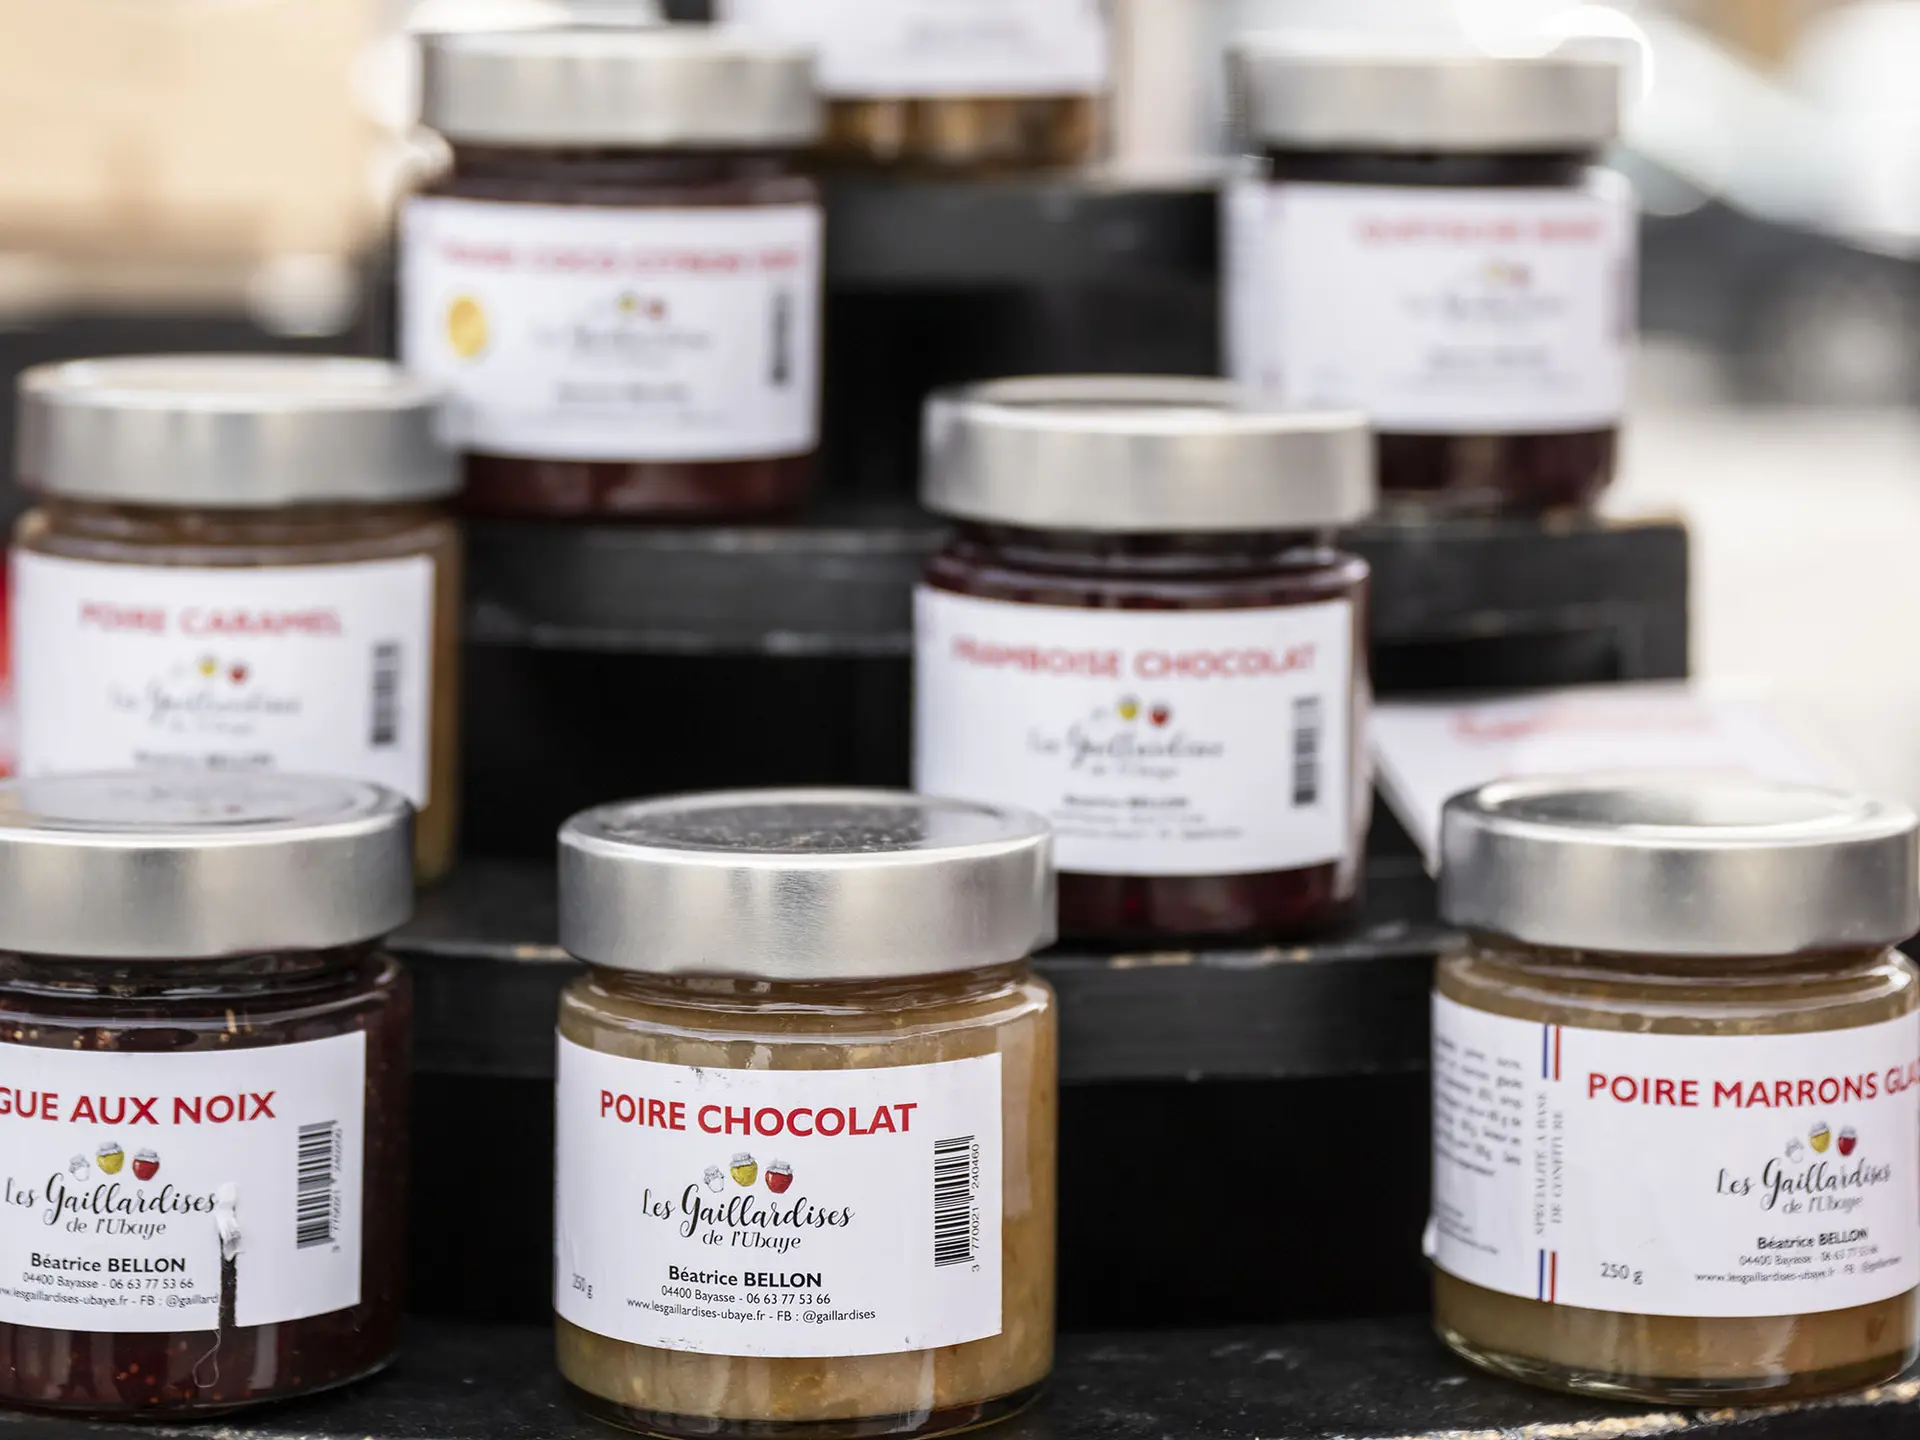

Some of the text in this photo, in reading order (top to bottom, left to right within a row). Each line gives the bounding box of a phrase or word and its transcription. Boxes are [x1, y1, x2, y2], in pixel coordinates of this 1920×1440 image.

[176, 605, 342, 640] CARAMEL
[951, 636, 1316, 680] FRAMBOISE CHOCOLAT
[1588, 1072, 1699, 1107] POIRE
[1713, 1072, 1877, 1109] MARRONS
[69, 1095, 160, 1126] AUX
[172, 1090, 277, 1125] NOIX
[599, 1089, 918, 1137] POIRE CHOCOLAT
[1716, 1157, 1893, 1212] Les Gaillardises
[5, 1172, 217, 1226] Les Gaillardises
[642, 1183, 856, 1238] Les Gaillardises
[971, 1142, 981, 1274] 3 770021 240460
[1781, 1199, 1803, 1215] de
[66, 1217, 167, 1240] de l'Ubaye
[702, 1229, 802, 1255] de l'Ubaye
[1756, 1226, 1869, 1251] Béatrice BELLON
[30, 1252, 186, 1273] Béatrice BELLON
[1600, 1262, 1644, 1286] 250 g
[23, 1272, 55, 1285] 04400
[56, 1276, 99, 1290] Bayasse
[109, 1278, 124, 1289] 06
[127, 1278, 142, 1290] 63
[145, 1278, 160, 1289] 77
[163, 1278, 177, 1289] 53
[180, 1278, 195, 1289] 66
[669, 1265, 823, 1289] Béatrice BELLON
[141, 1295, 155, 1307] FB
[661, 1285, 692, 1300] 04400
[694, 1289, 736, 1304] Bayasse
[746, 1293, 761, 1304] 06
[763, 1293, 778, 1305] 63
[781, 1293, 796, 1304] 77
[798, 1293, 813, 1305] 53
[816, 1293, 831, 1304] 66
[626, 1297, 766, 1323] www.lesgaillardises-ubaye.fr
[777, 1310, 792, 1322] FB
[802, 1309, 877, 1325] @gaillardises
